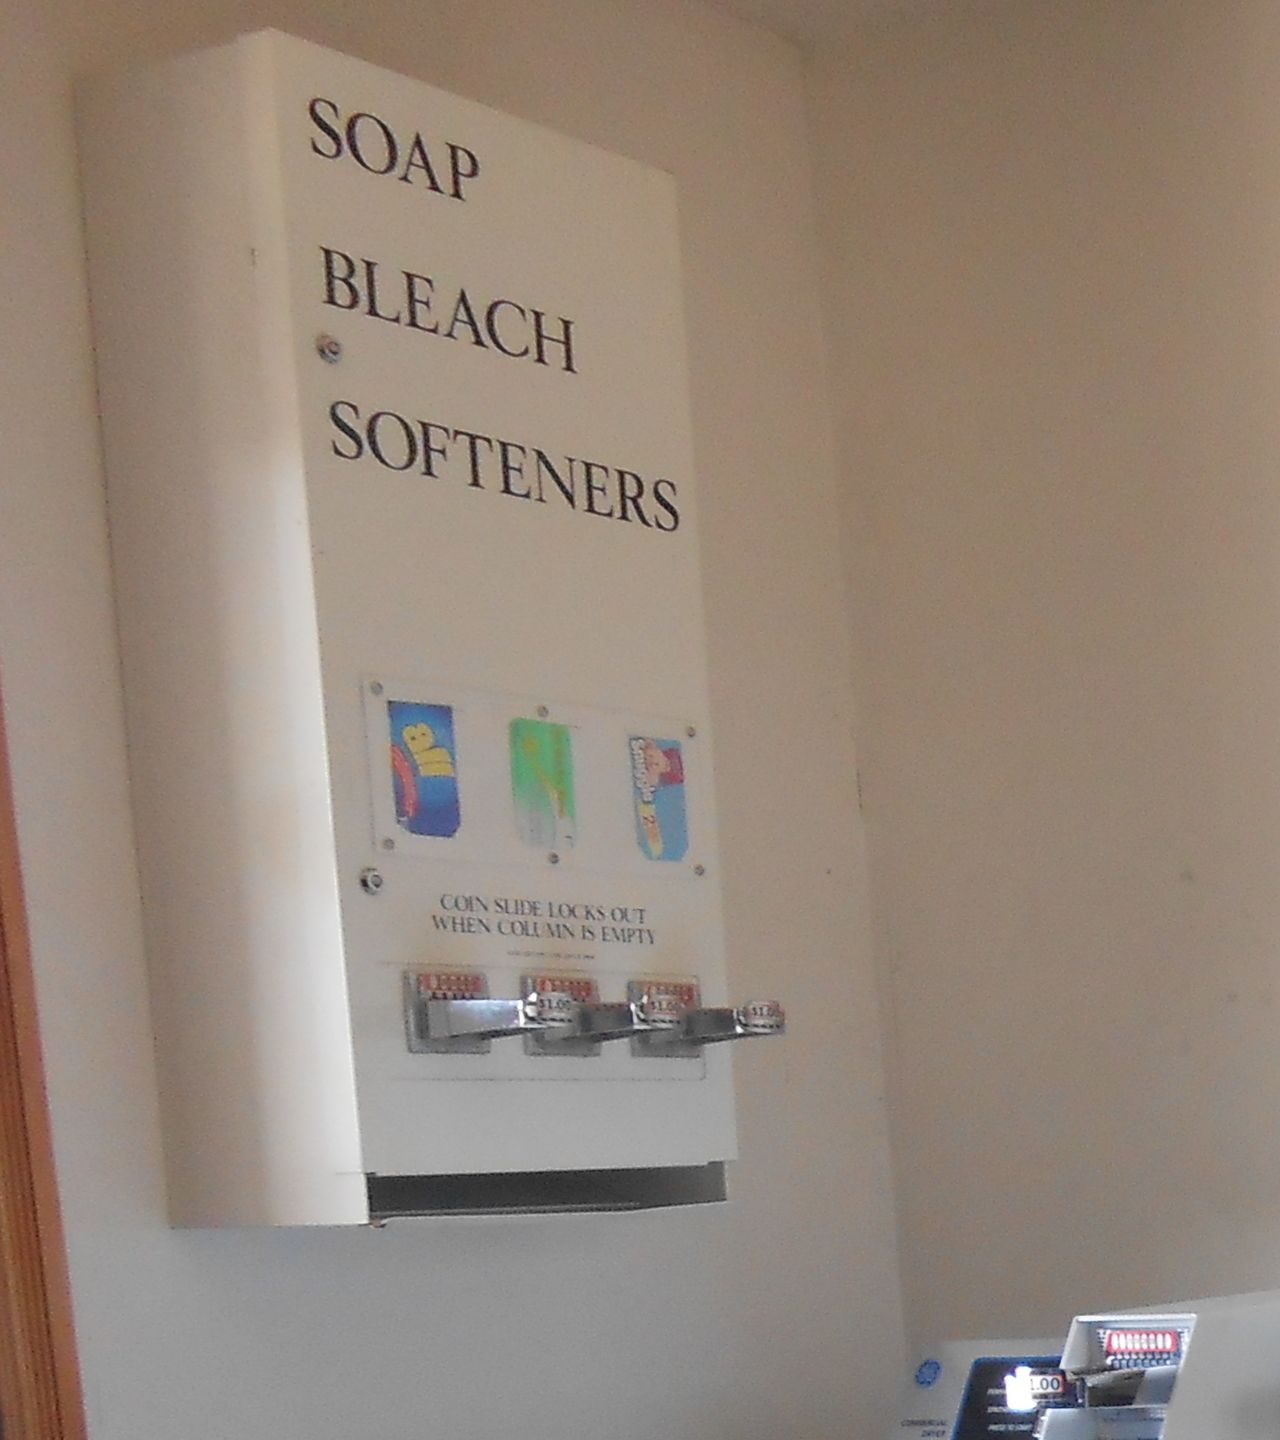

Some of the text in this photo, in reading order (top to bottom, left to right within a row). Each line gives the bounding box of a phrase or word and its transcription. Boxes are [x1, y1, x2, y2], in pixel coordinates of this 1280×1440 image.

[308, 97, 480, 201] SOAP
[319, 245, 578, 373] BLEACH
[329, 400, 680, 532] SOFTENERS
[431, 914, 656, 946] WHEN COLUMN IS EMPTY
[440, 893, 647, 925] COIN SLIDE LOCKS OUT
